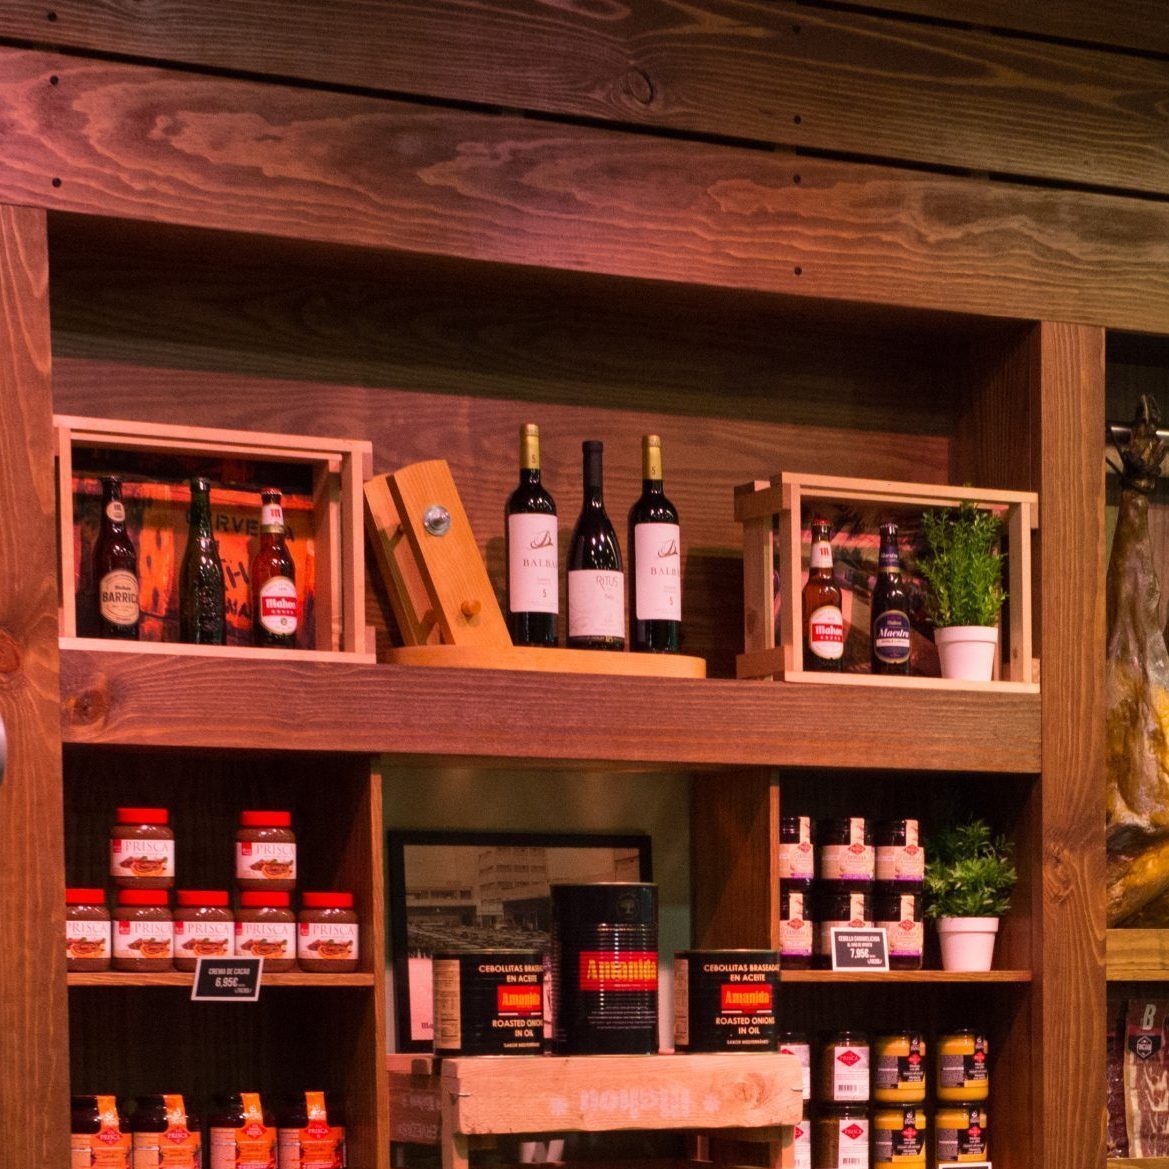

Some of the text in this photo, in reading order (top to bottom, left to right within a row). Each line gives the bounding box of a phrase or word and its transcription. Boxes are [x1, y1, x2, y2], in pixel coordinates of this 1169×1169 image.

[125, 841, 168, 852] PRISCA
[312, 924, 355, 936] PRISCA
[478, 964, 523, 973] CEBOLLITAS
[703, 963, 748, 972] CEBOLLITAS
[506, 974, 517, 983] EN
[730, 973, 740, 982] EN
[492, 1019, 526, 1028] ROASTED
[715, 1016, 750, 1025] ROASTED
[514, 1029, 523, 1037] IN
[738, 1026, 761, 1035] IN OIL
